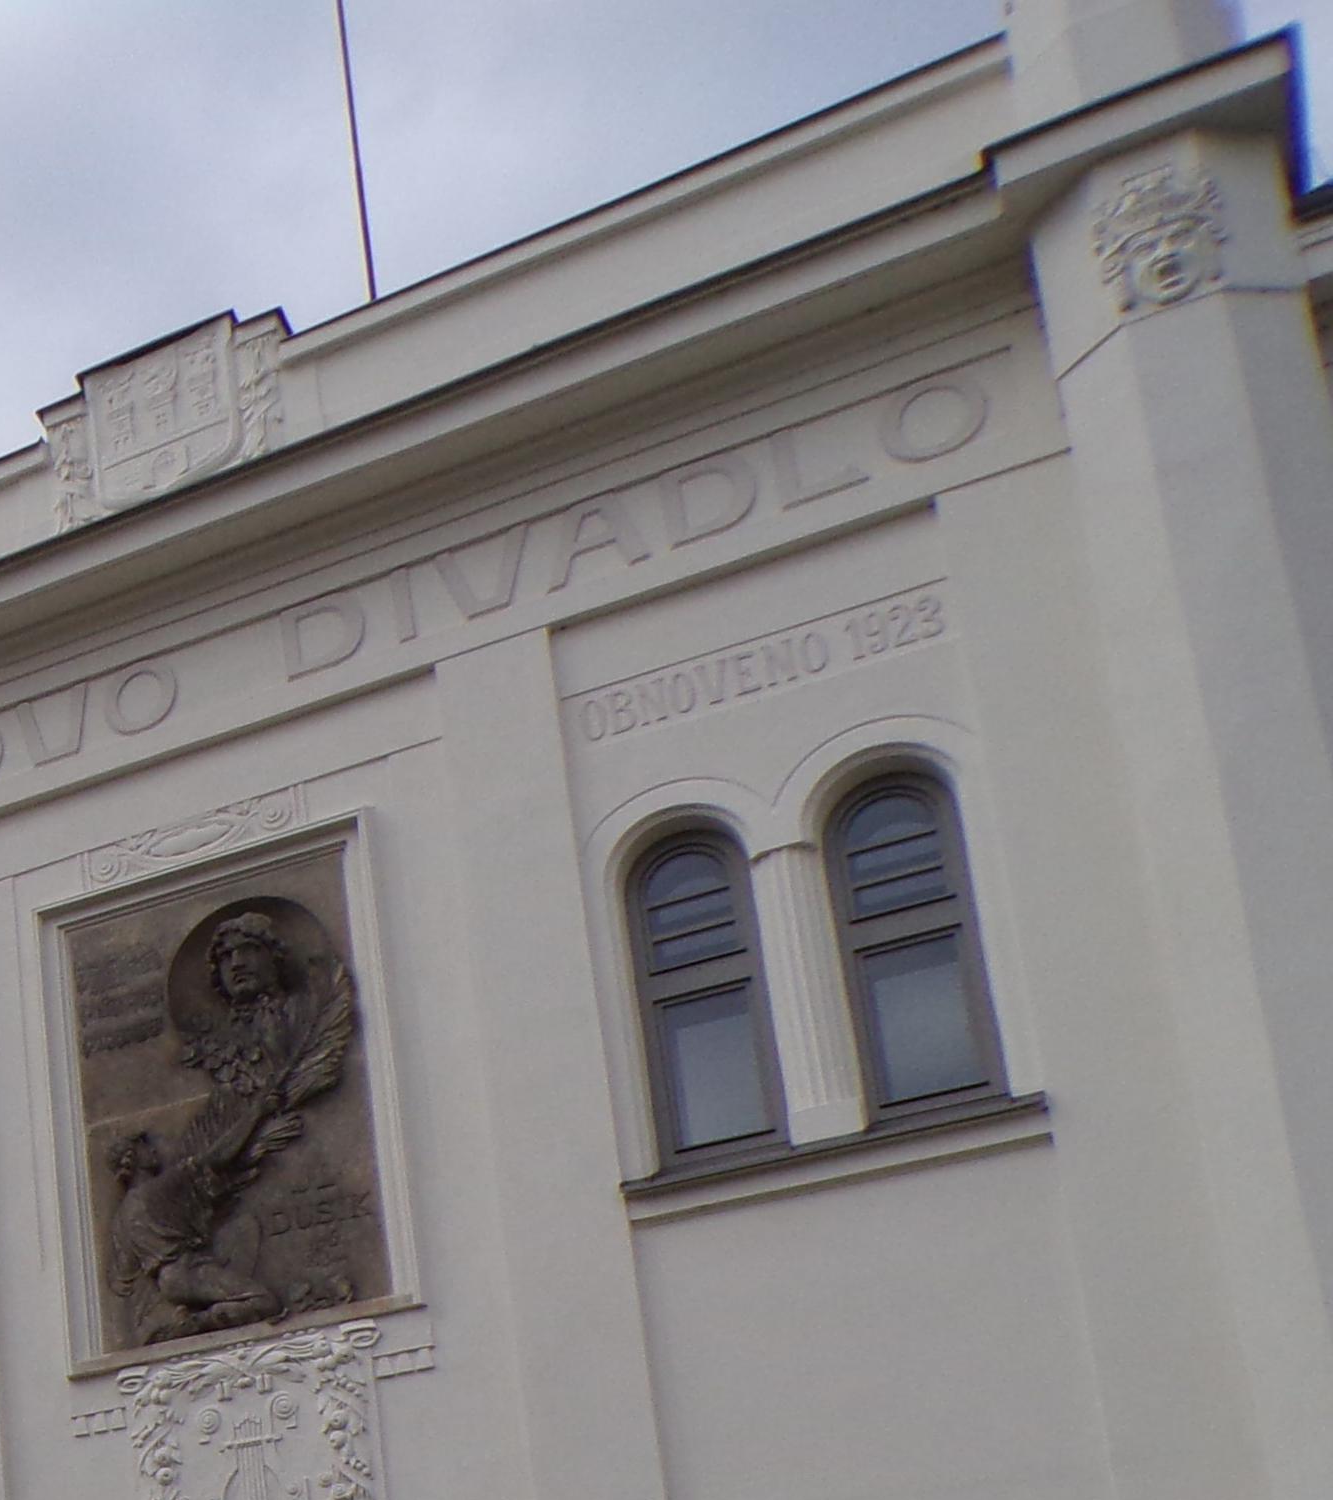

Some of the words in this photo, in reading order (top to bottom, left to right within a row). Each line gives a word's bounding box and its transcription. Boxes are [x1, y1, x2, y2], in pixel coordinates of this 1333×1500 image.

[279, 379, 989, 683] DIVADLO
[579, 632, 830, 742] OBNOVENO
[842, 594, 945, 661] 1923
